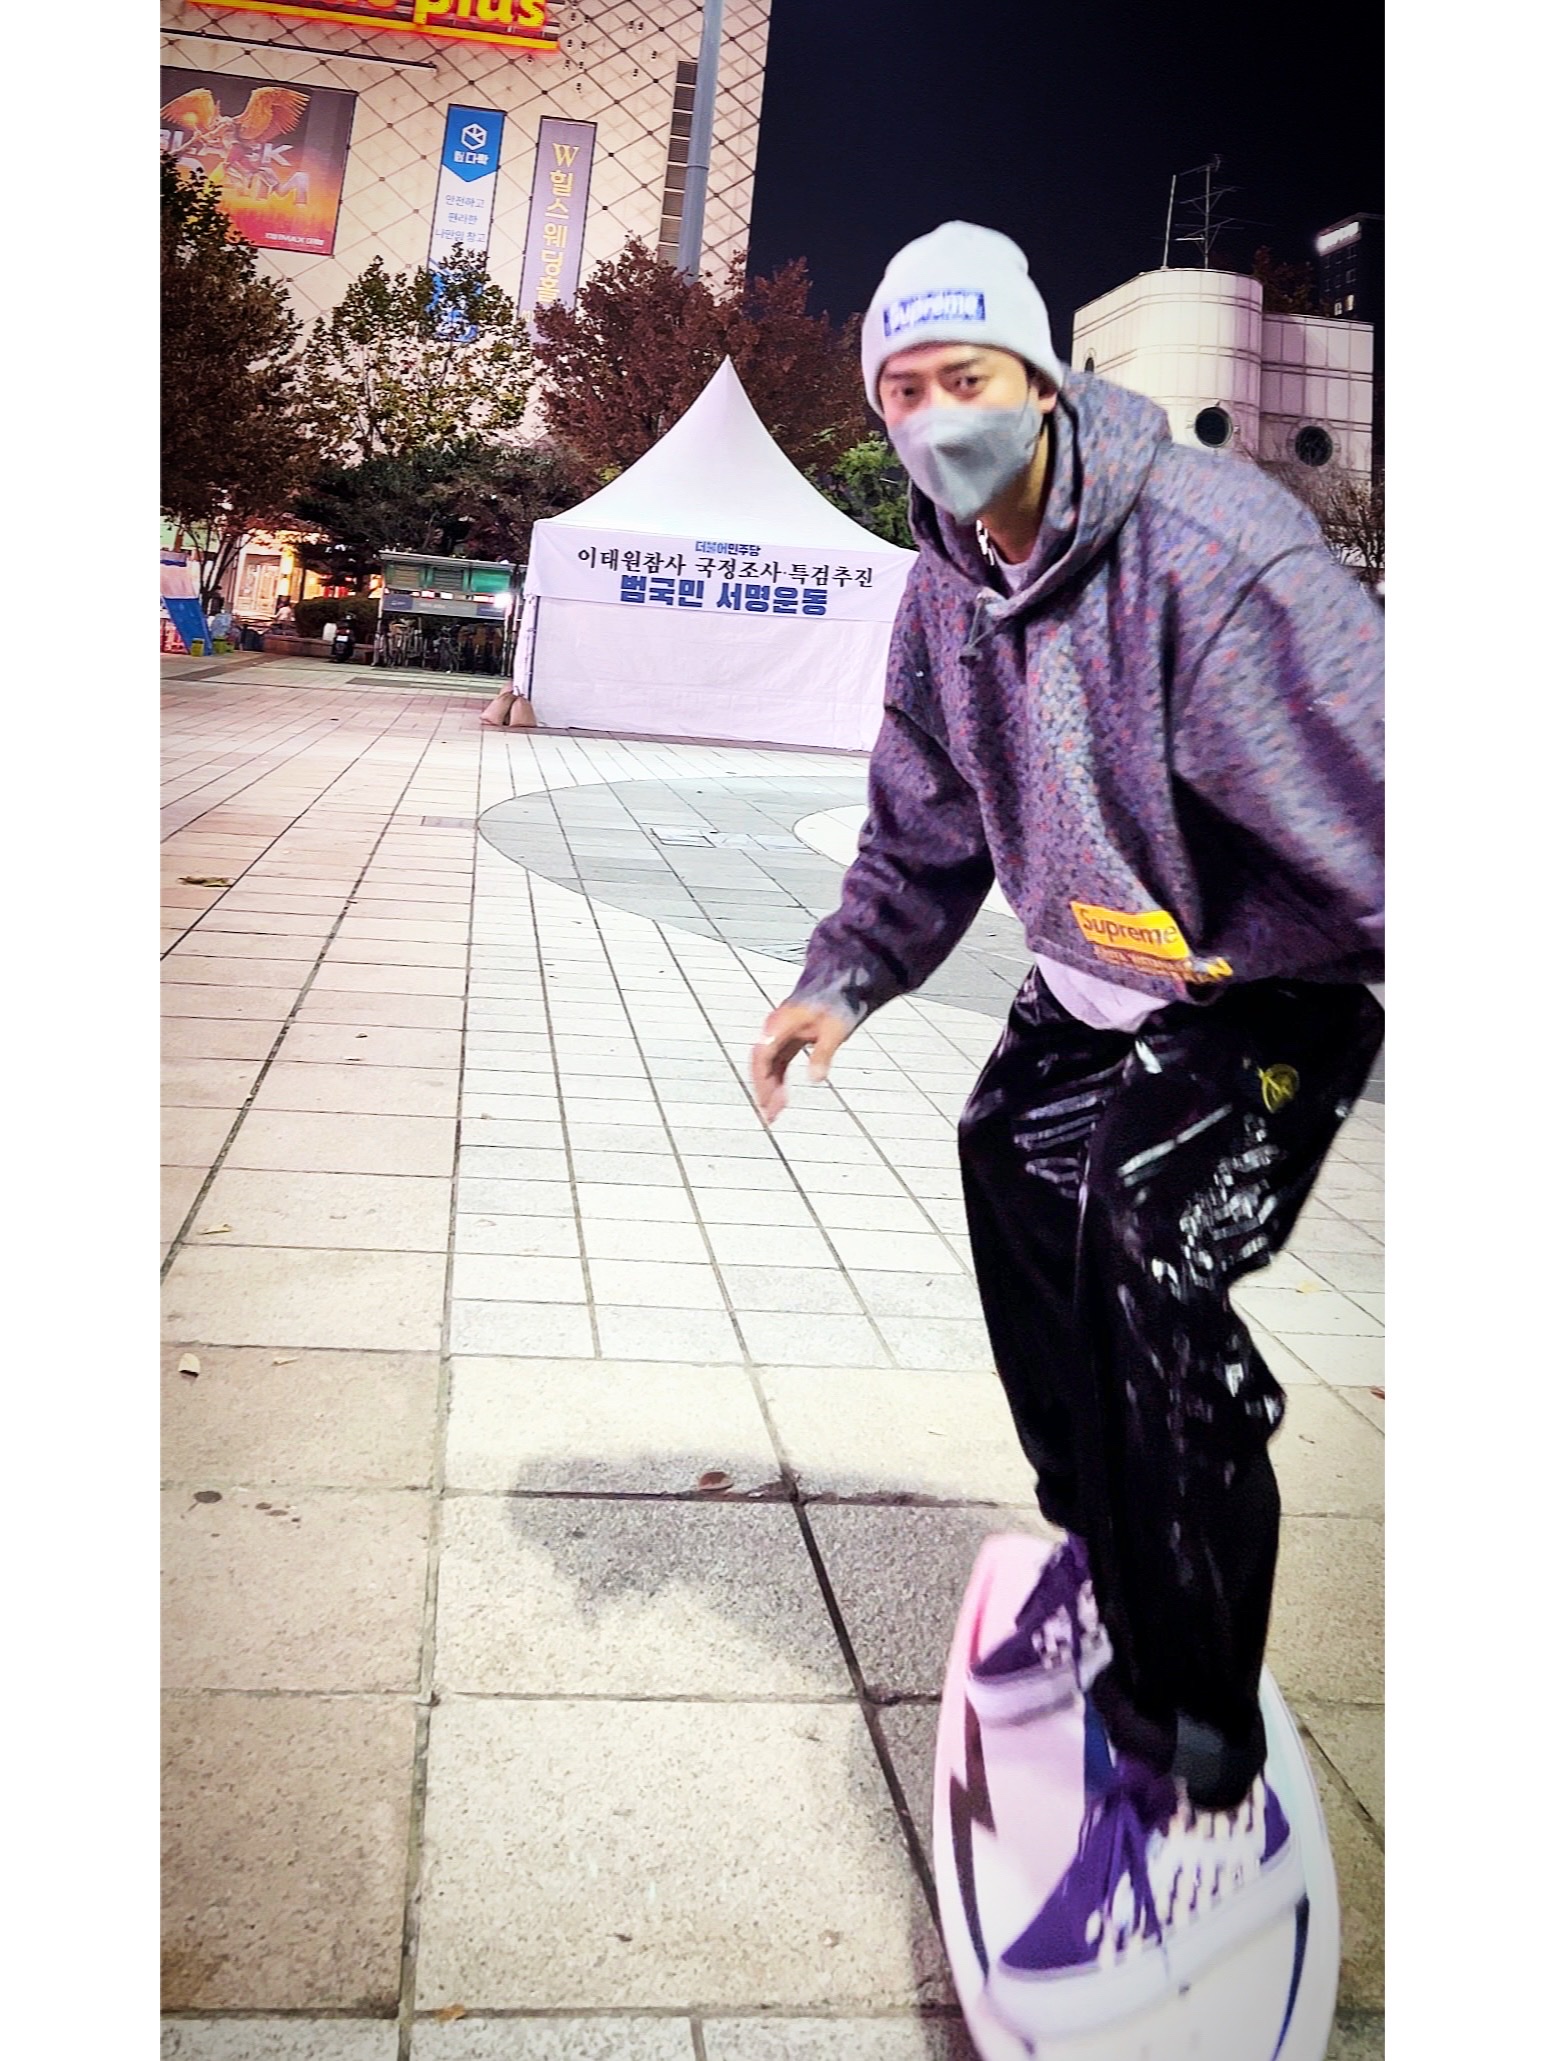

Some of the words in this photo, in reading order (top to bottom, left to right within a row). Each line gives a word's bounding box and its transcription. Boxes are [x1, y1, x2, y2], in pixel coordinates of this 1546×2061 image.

[578, 546, 686, 576] 이태원참사
[695, 541, 761, 557] 더불어민주당
[620, 574, 705, 608] 범국민
[716, 582, 828, 616] 서명운동
